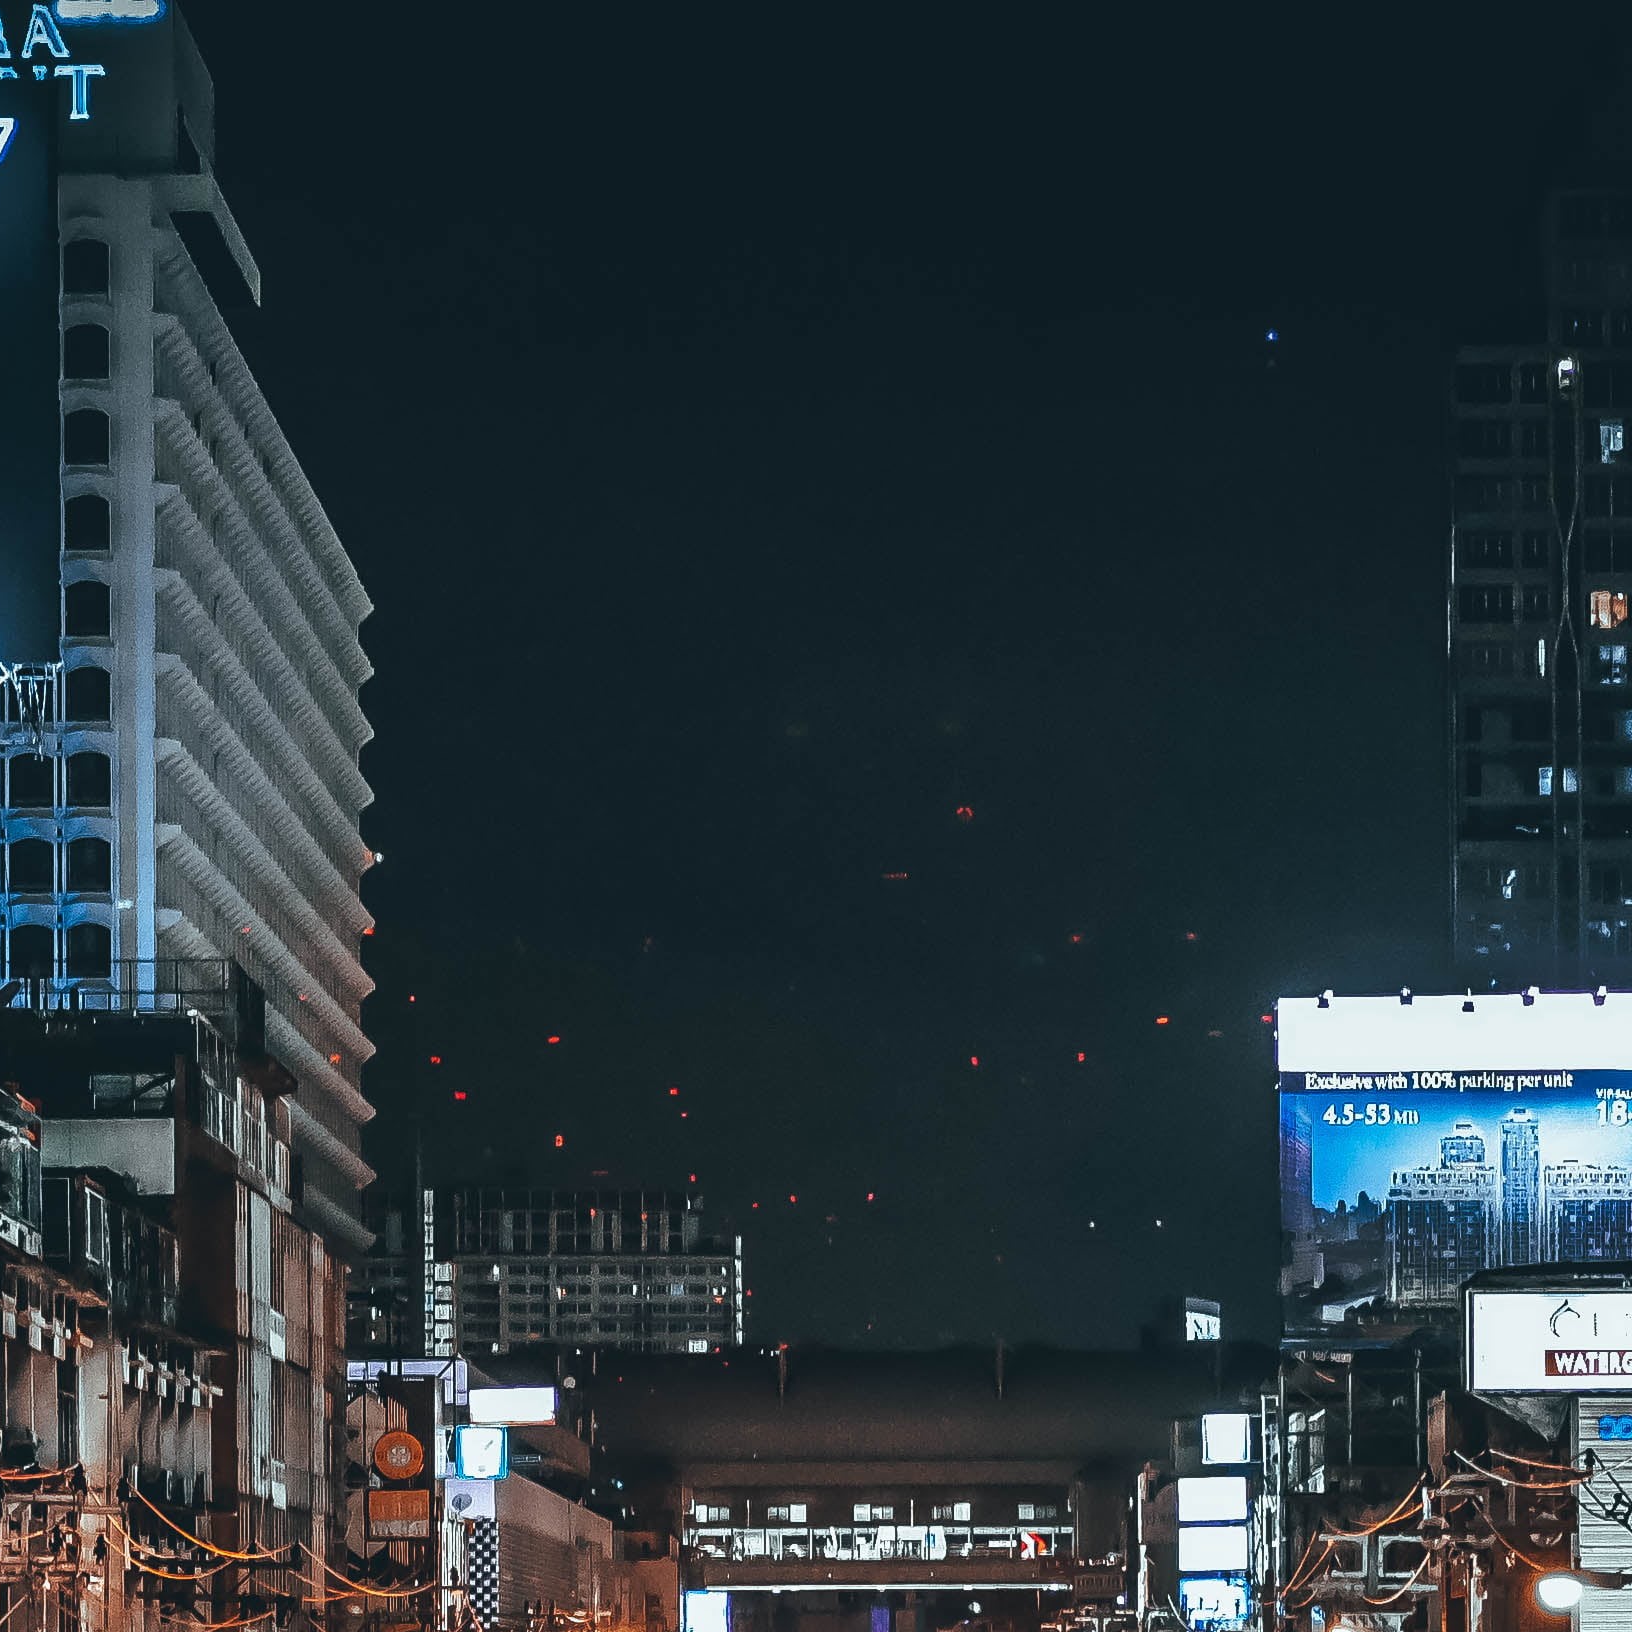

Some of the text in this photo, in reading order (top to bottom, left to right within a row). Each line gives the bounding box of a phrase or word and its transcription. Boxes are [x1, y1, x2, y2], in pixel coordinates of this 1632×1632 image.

[1305, 1071, 1573, 1092] Exclusive with 100% parking per unit
[1323, 1104, 1391, 1125] 4.5-53
